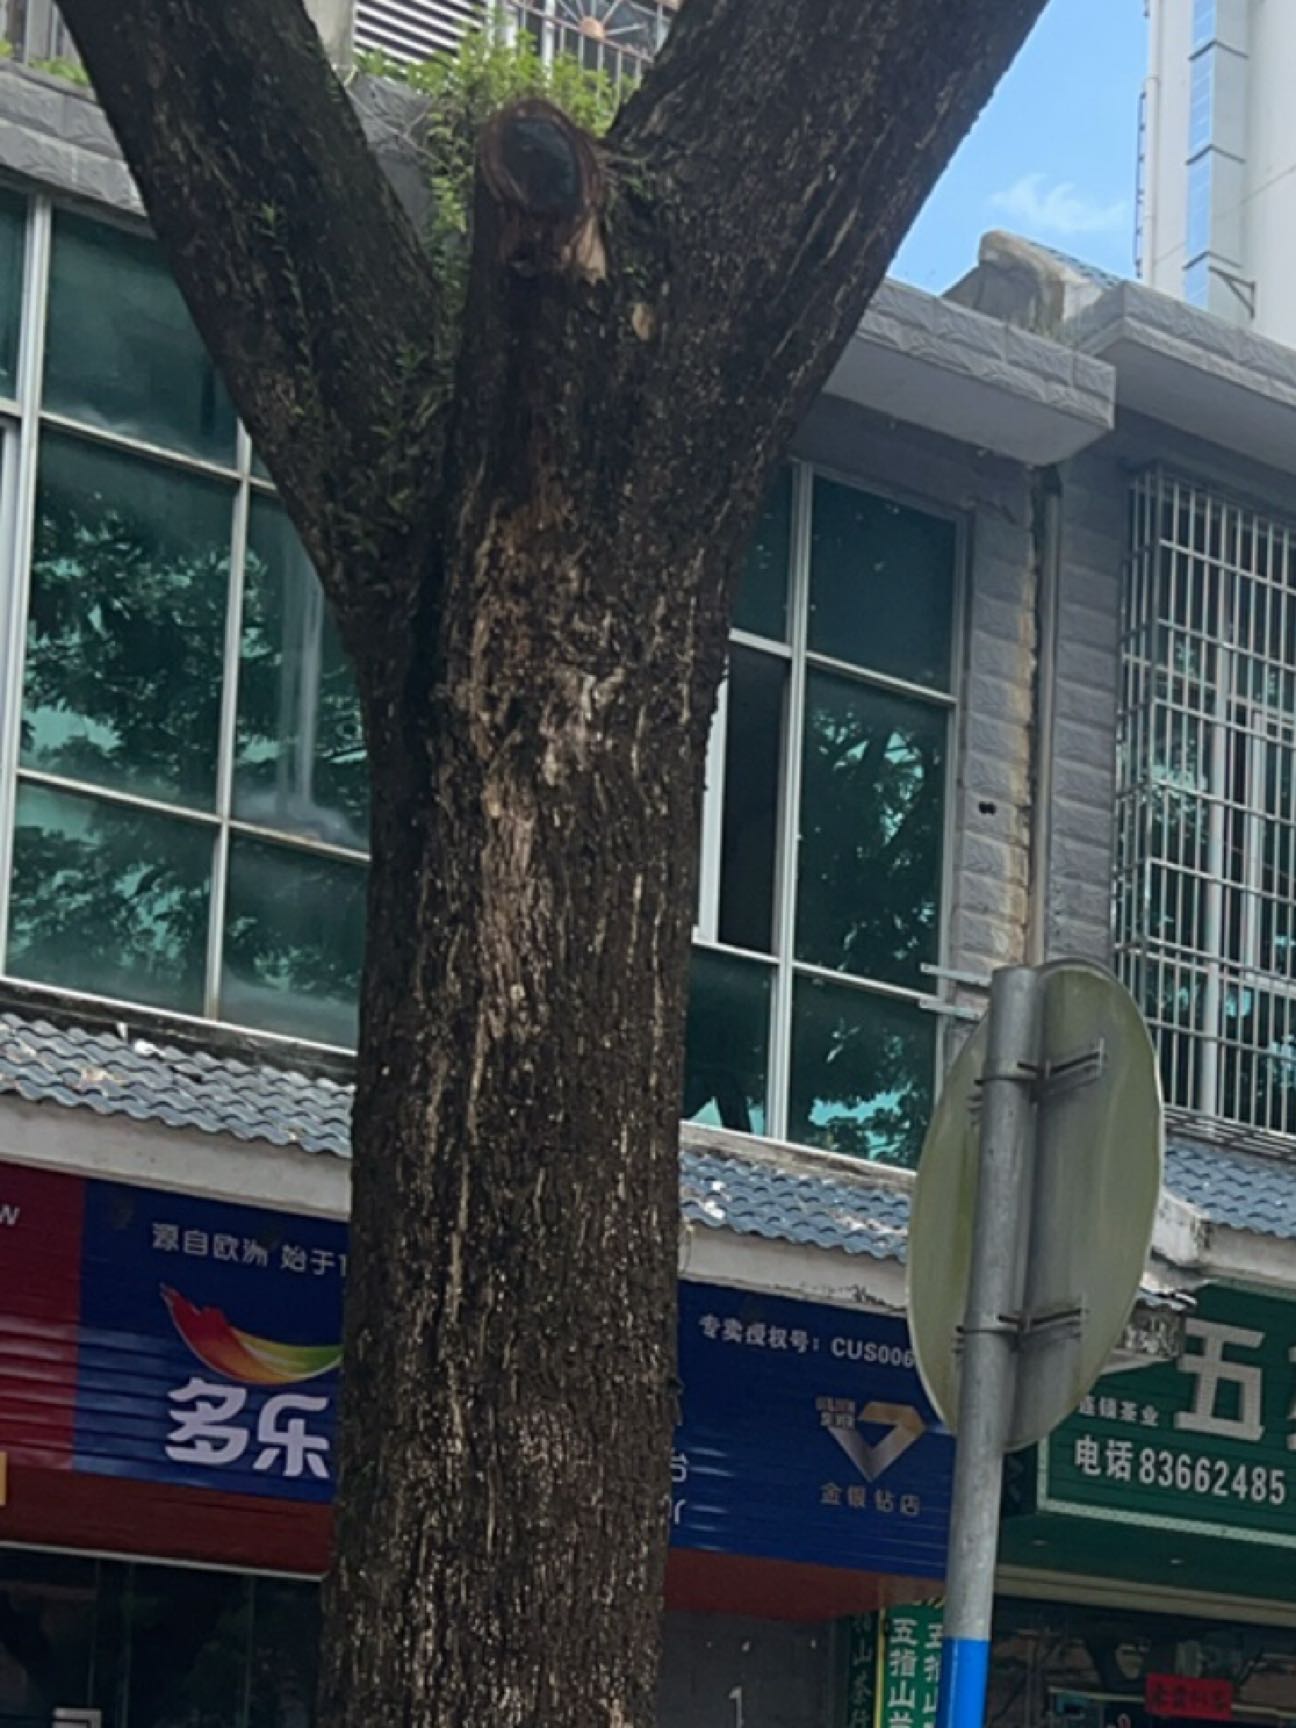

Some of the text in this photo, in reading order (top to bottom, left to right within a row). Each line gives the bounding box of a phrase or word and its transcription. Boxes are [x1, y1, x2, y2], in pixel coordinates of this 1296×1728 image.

[152, 1222, 269, 1267] 源自欧洲
[164, 1376, 331, 1480] 多乐
